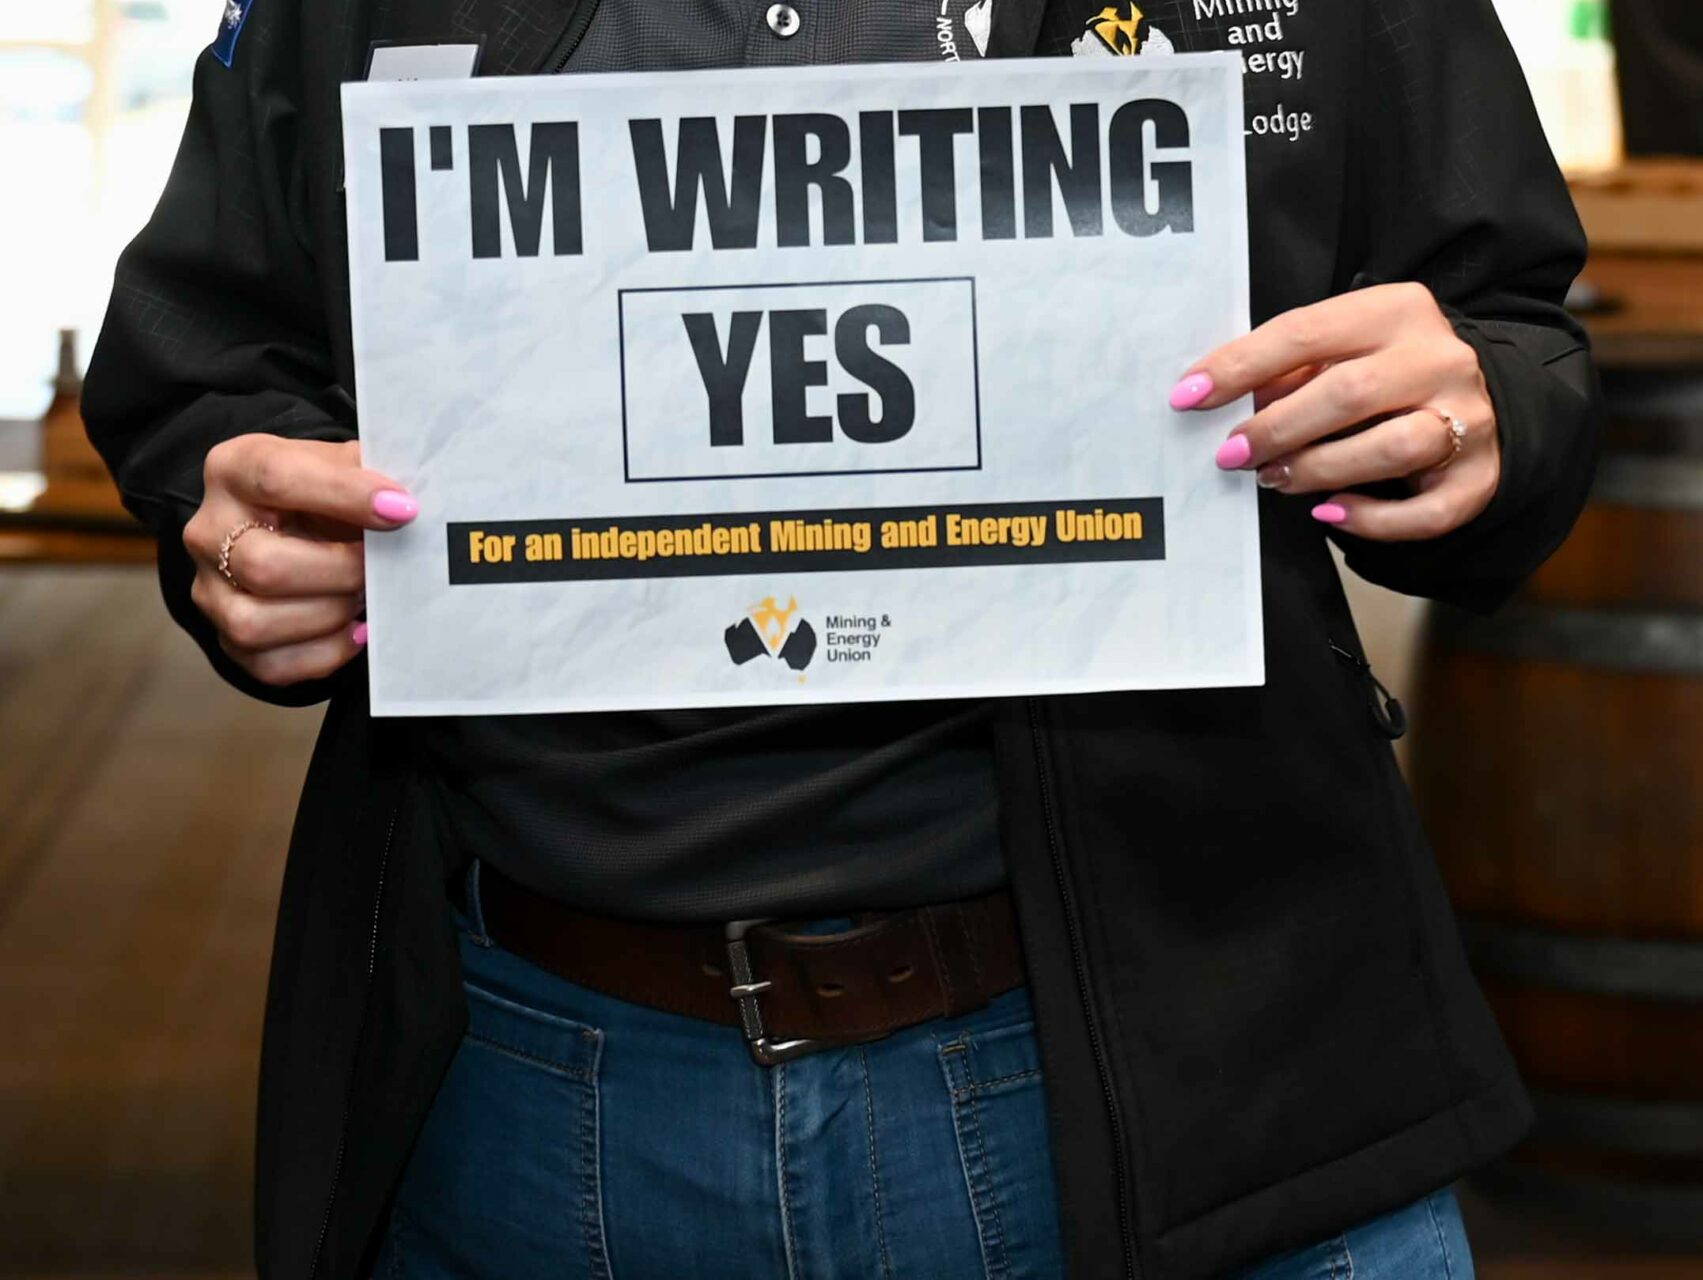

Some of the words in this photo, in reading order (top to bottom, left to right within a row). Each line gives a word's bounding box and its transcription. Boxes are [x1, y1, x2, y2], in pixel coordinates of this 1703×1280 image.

[1227, 11, 1284, 45] and
[1243, 103, 1313, 142] odge
[379, 121, 584, 262] I'M
[629, 98, 1196, 253] WRITING
[681, 304, 916, 448] YES
[468, 530, 517, 563] For
[524, 532, 563, 562] an
[571, 522, 763, 561] independent
[769, 519, 873, 553] Mining
[880, 514, 938, 549] and
[945, 513, 1048, 547] Energy
[1055, 508, 1143, 543] Union
[826, 614, 876, 631] Mining
[881, 613, 891, 627] &
[827, 631, 881, 648] Energy
[827, 648, 871, 662] Union
